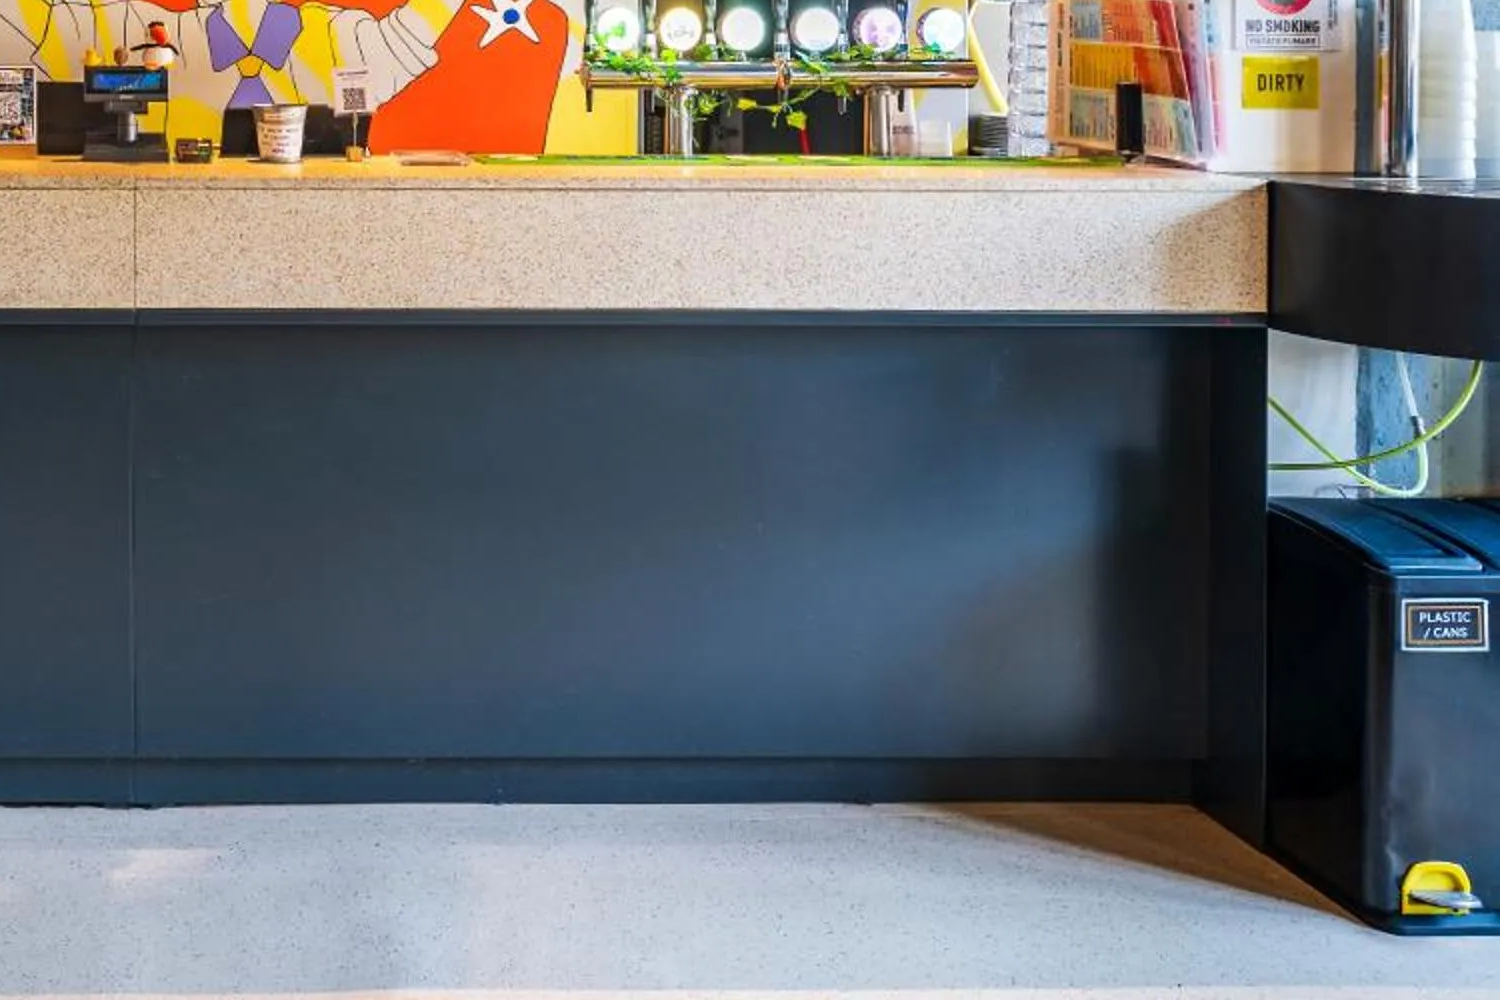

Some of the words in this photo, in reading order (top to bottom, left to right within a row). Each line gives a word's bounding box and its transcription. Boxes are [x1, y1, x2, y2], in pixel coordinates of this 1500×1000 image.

[1246, 20, 1263, 32] NO
[1266, 20, 1320, 33] SMOKING
[1257, 73, 1305, 92] DIRTY
[1419, 611, 1471, 623] PLASTIC
[1423, 627, 1431, 640] /
[1433, 627, 1468, 638] CANS
